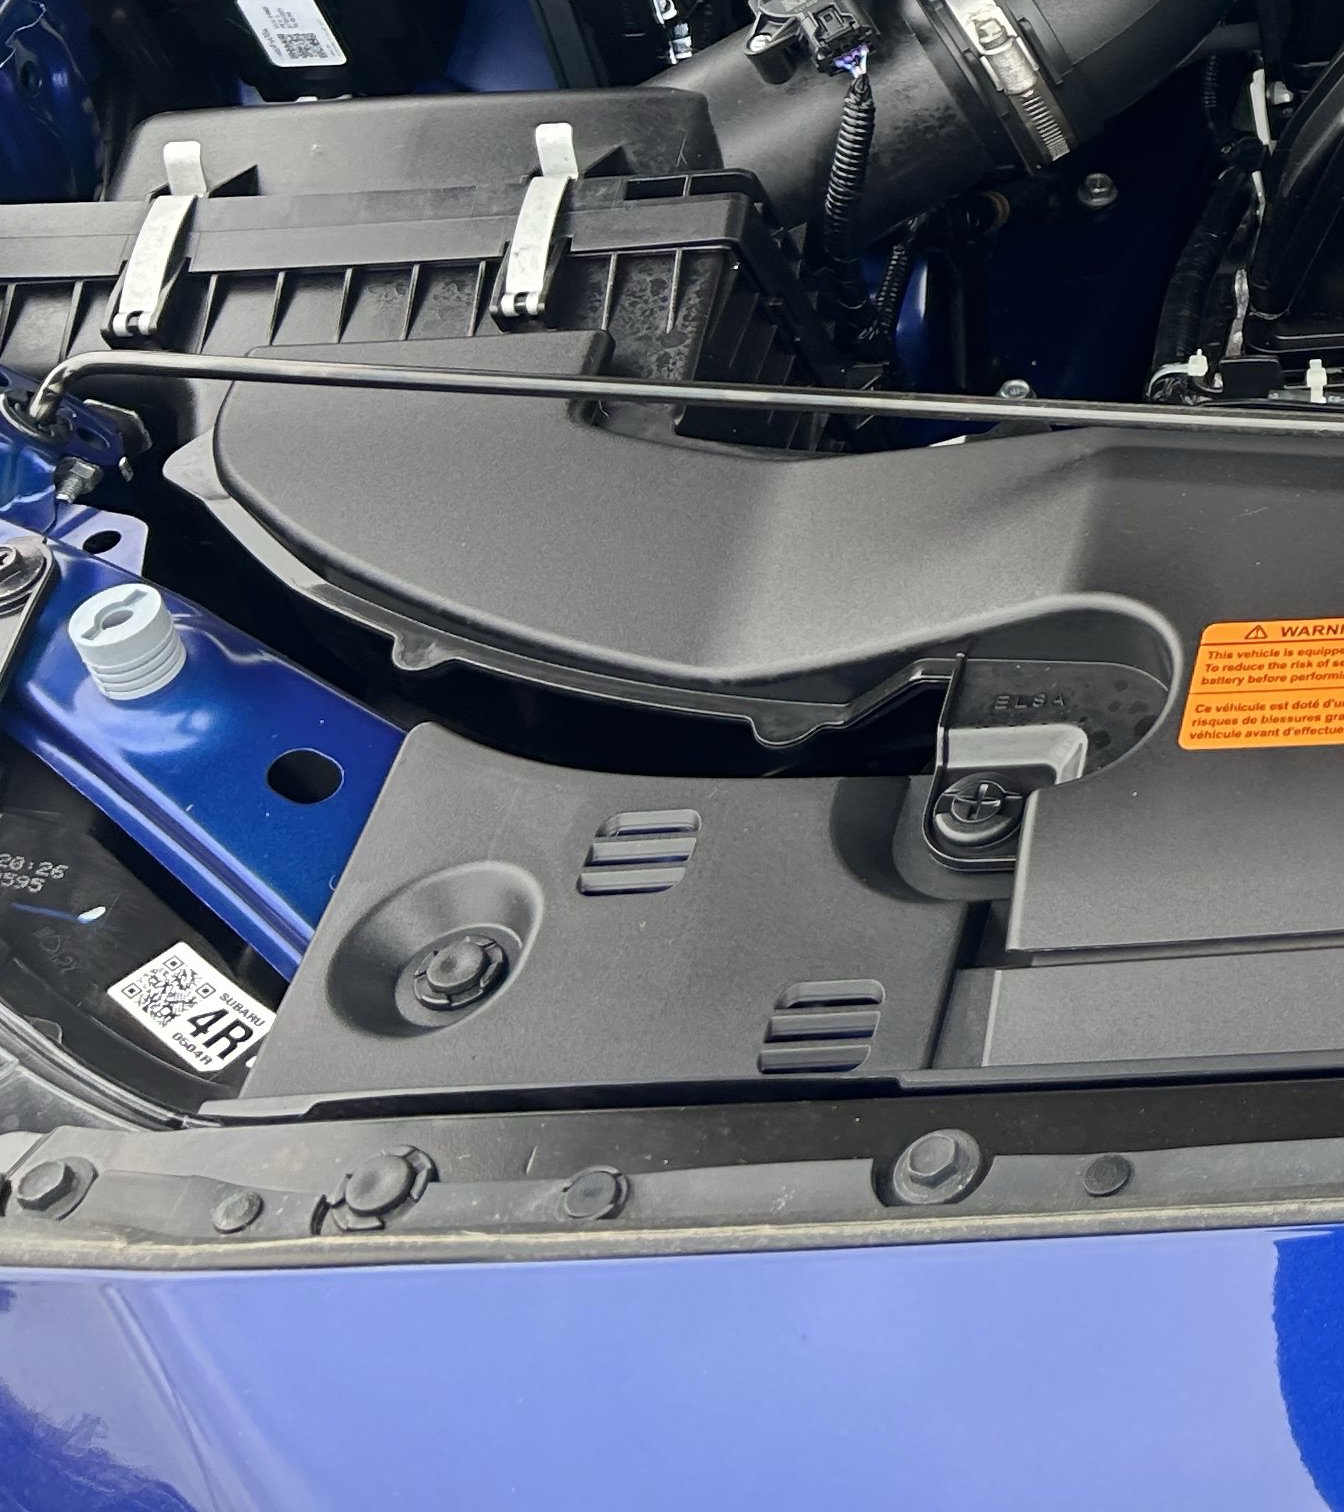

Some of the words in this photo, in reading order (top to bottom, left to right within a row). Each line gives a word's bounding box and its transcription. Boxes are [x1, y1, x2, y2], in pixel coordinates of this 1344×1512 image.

[1208, 650, 1233, 660] This
[1237, 648, 1279, 659] vehicle
[1205, 663, 1219, 673] To
[1222, 662, 1265, 672] reduce
[1268, 661, 1287, 670] the
[1290, 659, 1313, 669] risk
[1316, 658, 1330, 668] of
[1201, 676, 1243, 686] battery
[1247, 674, 1287, 684] before
[994, 693, 1065, 710] ELSA
[1195, 704, 1212, 713] Ce
[1215, 701, 1266, 712] véhicule
[1270, 701, 1289, 711] est
[1292, 699, 1319, 709] doté
[1191, 718, 1239, 728] risques
[1242, 716, 1257, 726] de
[1260, 713, 1322, 725] blessures
[1189, 729, 1242, 740] véhicule
[1245, 728, 1280, 738] avant
[219, 992, 266, 1028] SUBARU
[187, 1007, 254, 1062] 4R
